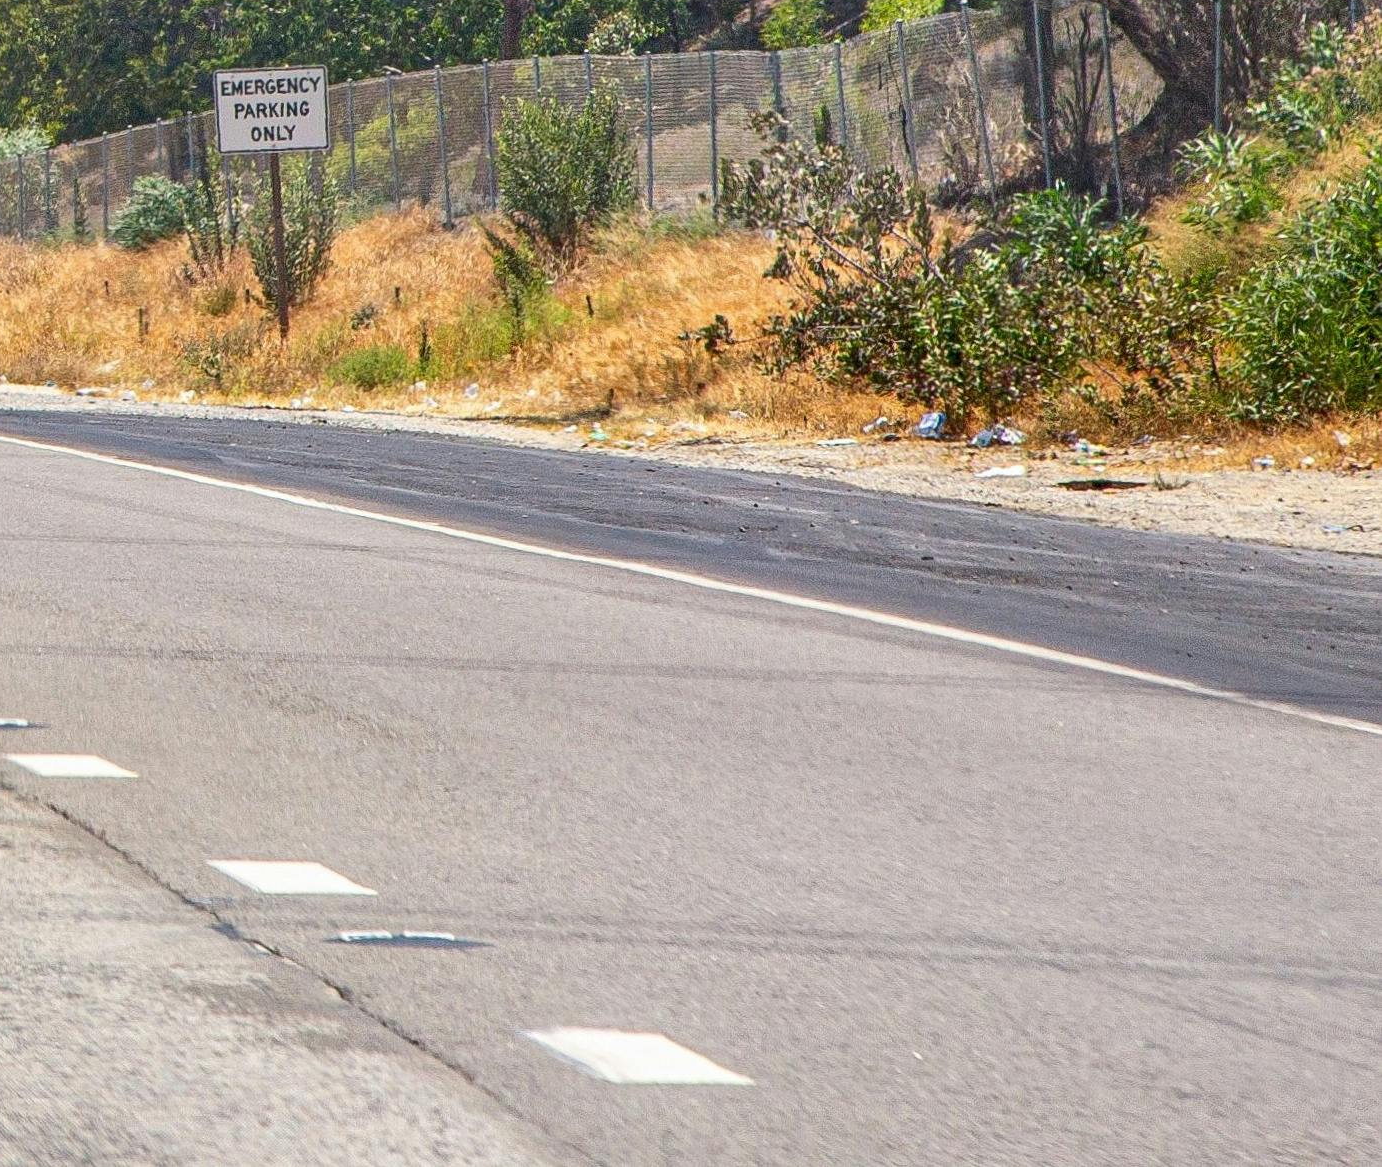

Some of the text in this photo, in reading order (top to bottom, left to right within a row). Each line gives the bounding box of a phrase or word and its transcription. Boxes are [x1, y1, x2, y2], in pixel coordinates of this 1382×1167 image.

[220, 76, 321, 96] EMERGENCY
[234, 101, 310, 119] PARKING
[251, 125, 296, 142] ONLY
